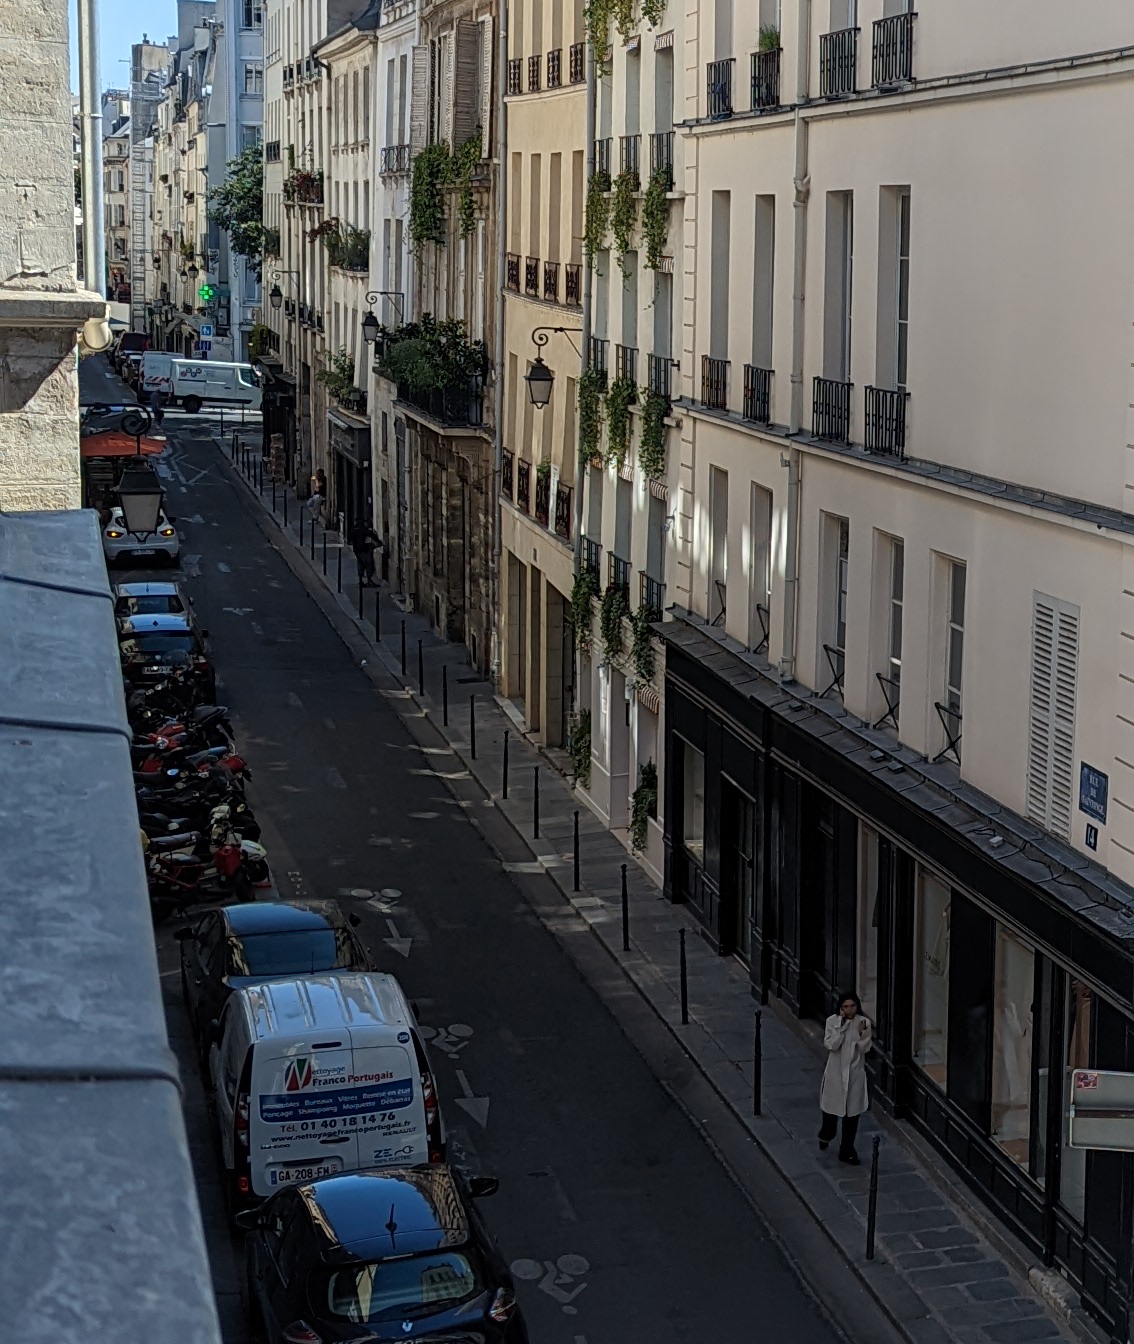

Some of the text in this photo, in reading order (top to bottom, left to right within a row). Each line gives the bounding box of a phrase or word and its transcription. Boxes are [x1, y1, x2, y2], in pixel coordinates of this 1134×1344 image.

[1086, 826, 1096, 847] 14
[312, 1071, 394, 1087] Franco Portugais
[304, 1097, 333, 1106] Bureaux
[337, 1094, 358, 1102] Vitres
[362, 1090, 386, 1099] Remise
[380, 1096, 411, 1106] Débarras
[280, 1111, 396, 1133] Tél. 01 40 18 14 76
